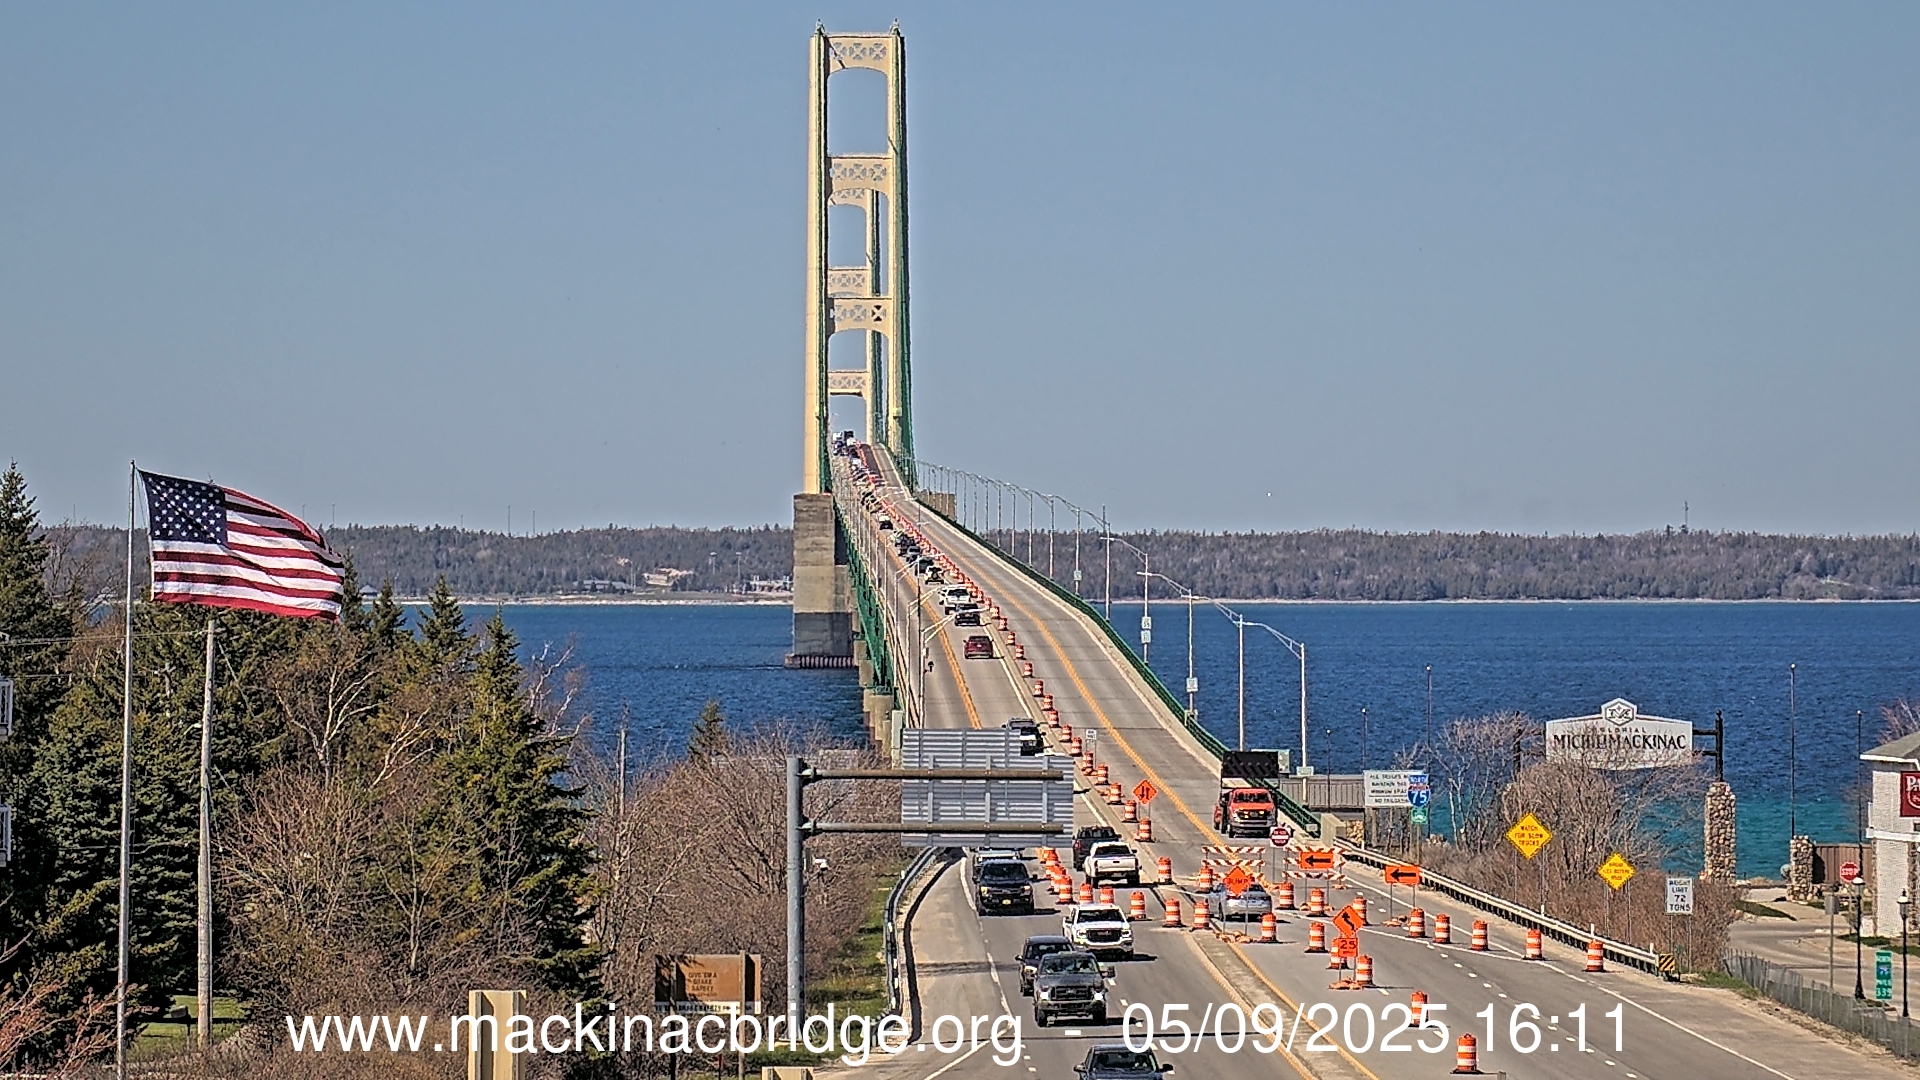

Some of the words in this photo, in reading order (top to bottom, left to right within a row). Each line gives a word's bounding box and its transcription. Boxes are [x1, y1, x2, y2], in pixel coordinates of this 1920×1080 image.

[1553, 734, 1687, 749] MICHILIMACKINAC
[1411, 791, 1427, 804] 75
[1674, 894, 1687, 902] 72
[1668, 903, 1691, 911] TONS
[1340, 939, 1356, 949] 25
